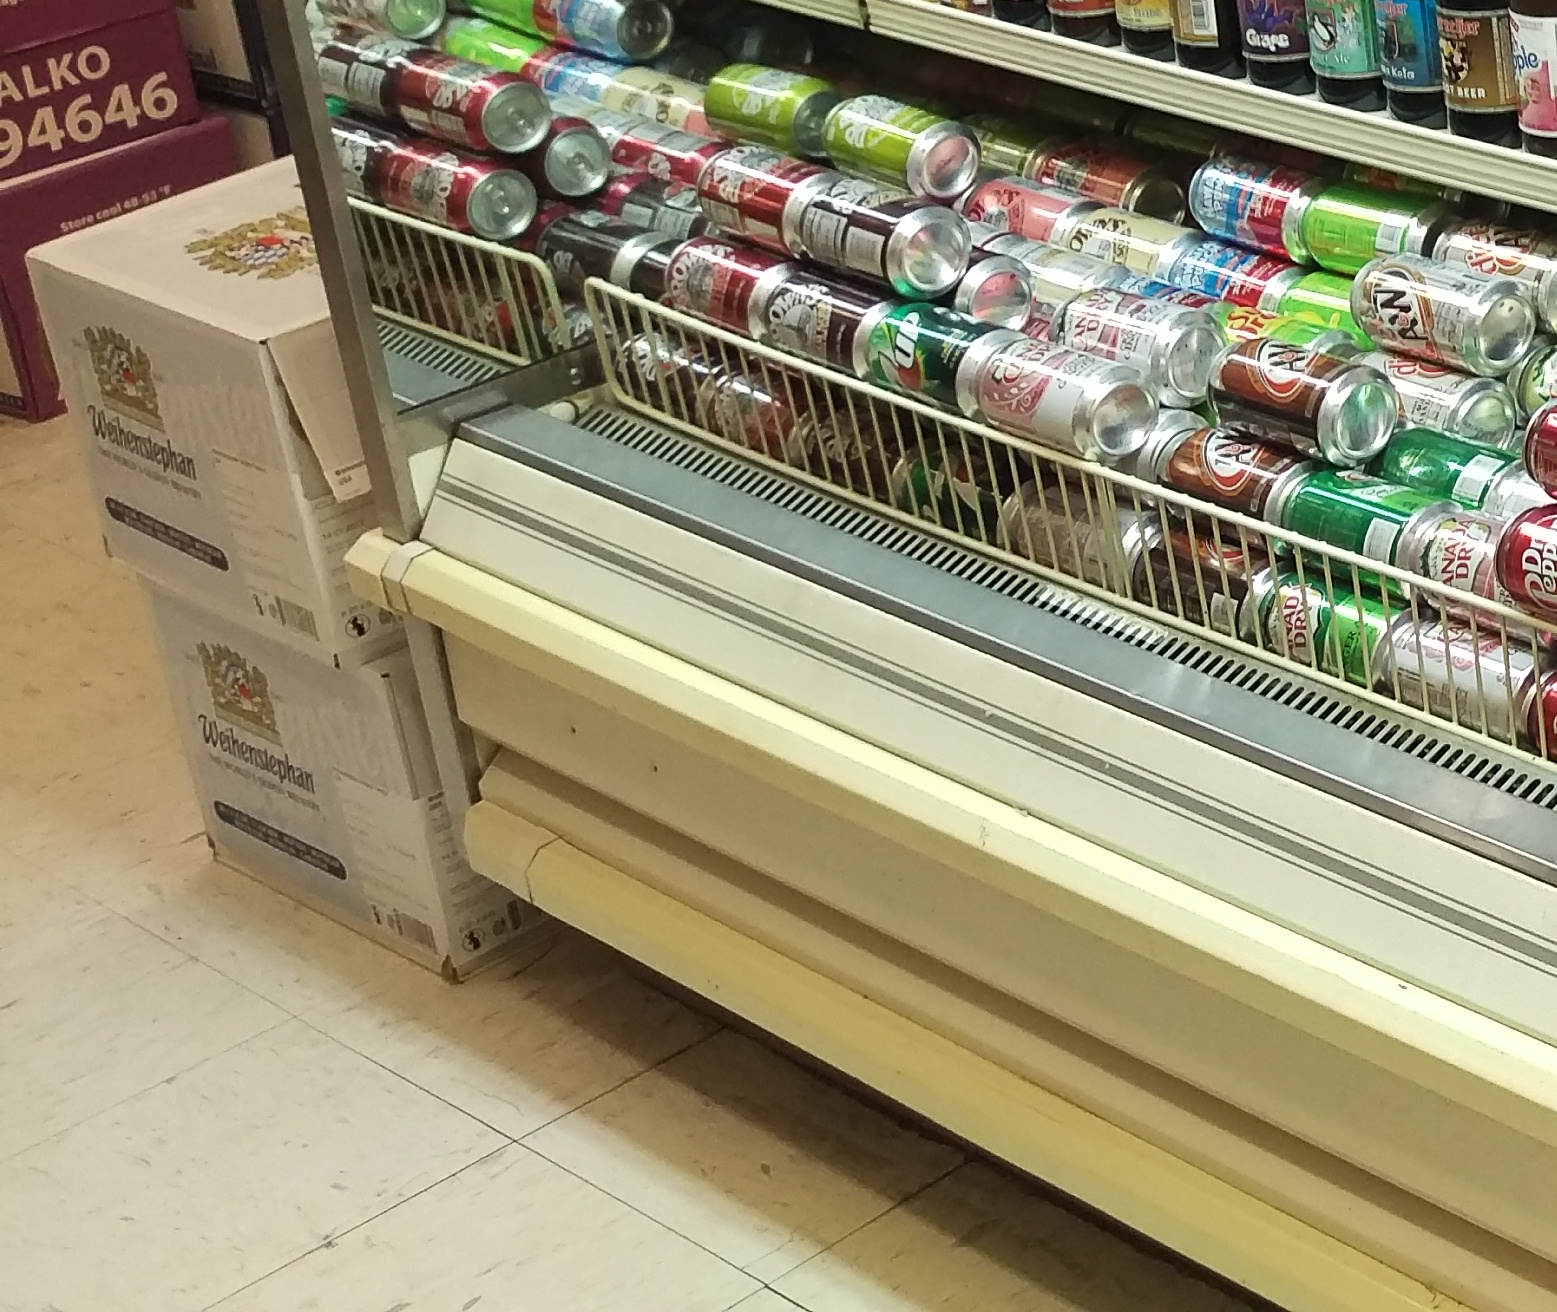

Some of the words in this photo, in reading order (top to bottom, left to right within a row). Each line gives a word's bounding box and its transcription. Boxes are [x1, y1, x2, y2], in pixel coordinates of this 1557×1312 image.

[1246, 29, 1290, 53] Grape
[61, 212, 94, 233] Store
[96, 203, 122, 221] cool
[88, 405, 197, 481] Weihenstephan
[198, 715, 315, 795] Weihenstephan
